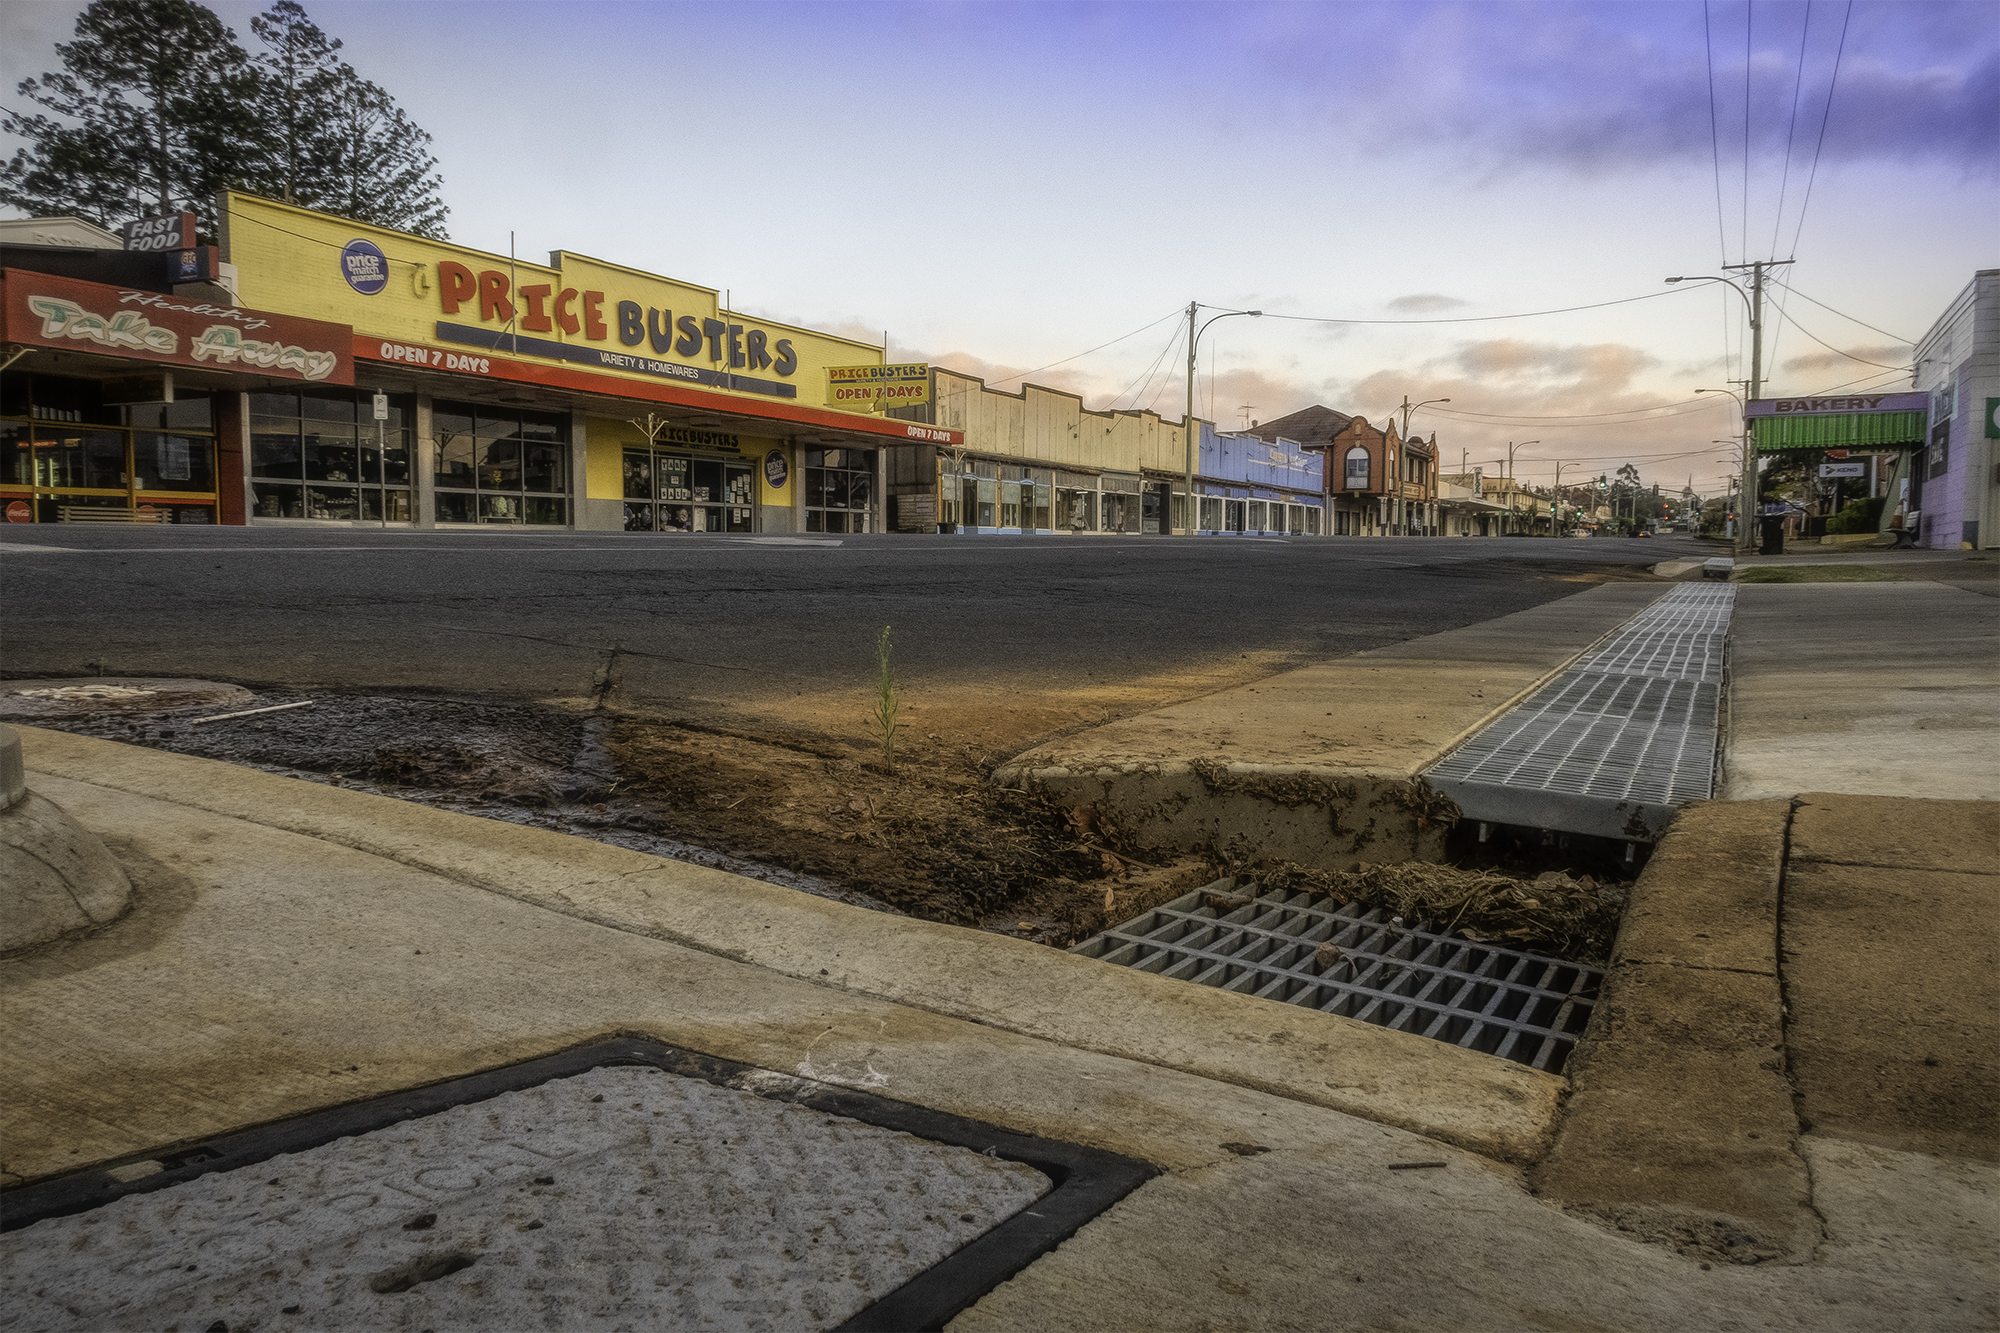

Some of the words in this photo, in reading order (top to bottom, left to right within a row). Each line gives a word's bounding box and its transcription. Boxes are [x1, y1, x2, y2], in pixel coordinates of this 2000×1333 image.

[130, 216, 178, 238] FAST
[128, 232, 180, 250] FOOD
[346, 253, 379, 271] price
[352, 265, 379, 275] match
[351, 273, 384, 284] guarantee
[118, 291, 270, 329] Healthy
[439, 261, 608, 340] PRICE
[618, 300, 798, 377] BUSTERS
[28, 295, 178, 354] Take
[190, 325, 336, 380] Away
[380, 342, 428, 364] OPEN
[431, 351, 443, 366] 7
[446, 353, 490, 374] DAYS
[600, 352, 636, 368] VARIETY
[638, 359, 645, 370] &
[648, 361, 699, 379] HOMEWARES
[830, 367, 869, 379] PRICE
[870, 366, 927, 378] BUSTERS
[835, 388, 871, 400] OPEN
[875, 387, 883, 399] 7
[886, 386, 923, 398] DAYS
[1775, 398, 1885, 412] BAKERY
[689, 430, 739, 447] BUSTERS
[907, 425, 926, 439] OPEN
[927, 430, 931, 439] 7
[933, 430, 951, 442] DAYS
